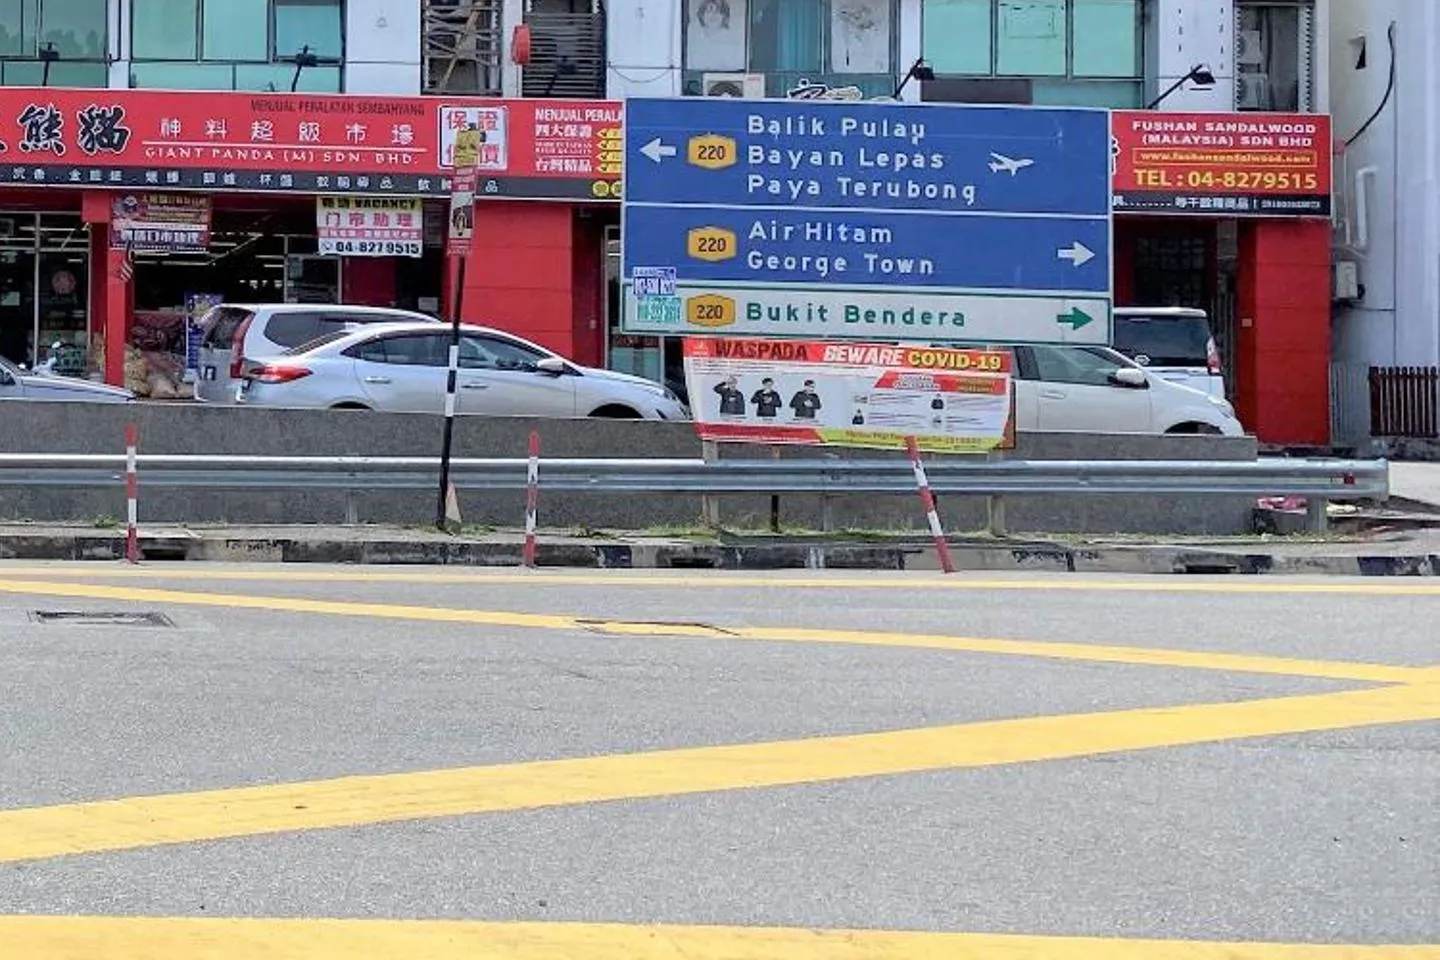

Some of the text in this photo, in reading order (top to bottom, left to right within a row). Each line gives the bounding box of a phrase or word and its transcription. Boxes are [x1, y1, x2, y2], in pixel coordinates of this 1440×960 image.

[748, 115, 825, 136] Balik
[1132, 120, 1316, 134] FUSHAN SANDALWOOD
[1142, 134, 1313, 147] (MALAYSIA) SDN BHD
[145, 147, 203, 159] GIANT
[212, 149, 274, 161] PANDA
[283, 150, 314, 163] (M)
[375, 153, 419, 165] BHD.
[698, 144, 726, 161] 220
[748, 145, 945, 172] Bayan Lepas
[747, 175, 977, 206] Paya Terubong
[1188, 171, 1318, 189] 04-8279515
[748, 220, 892, 244] Air Hitam
[698, 236, 727, 254] 220
[748, 251, 934, 279] George Town
[697, 304, 724, 321] 220
[746, 302, 966, 328] Bukit Bendera
[714, 339, 809, 361] WASPADA
[823, 343, 1002, 370] BEWARE COVID-19
